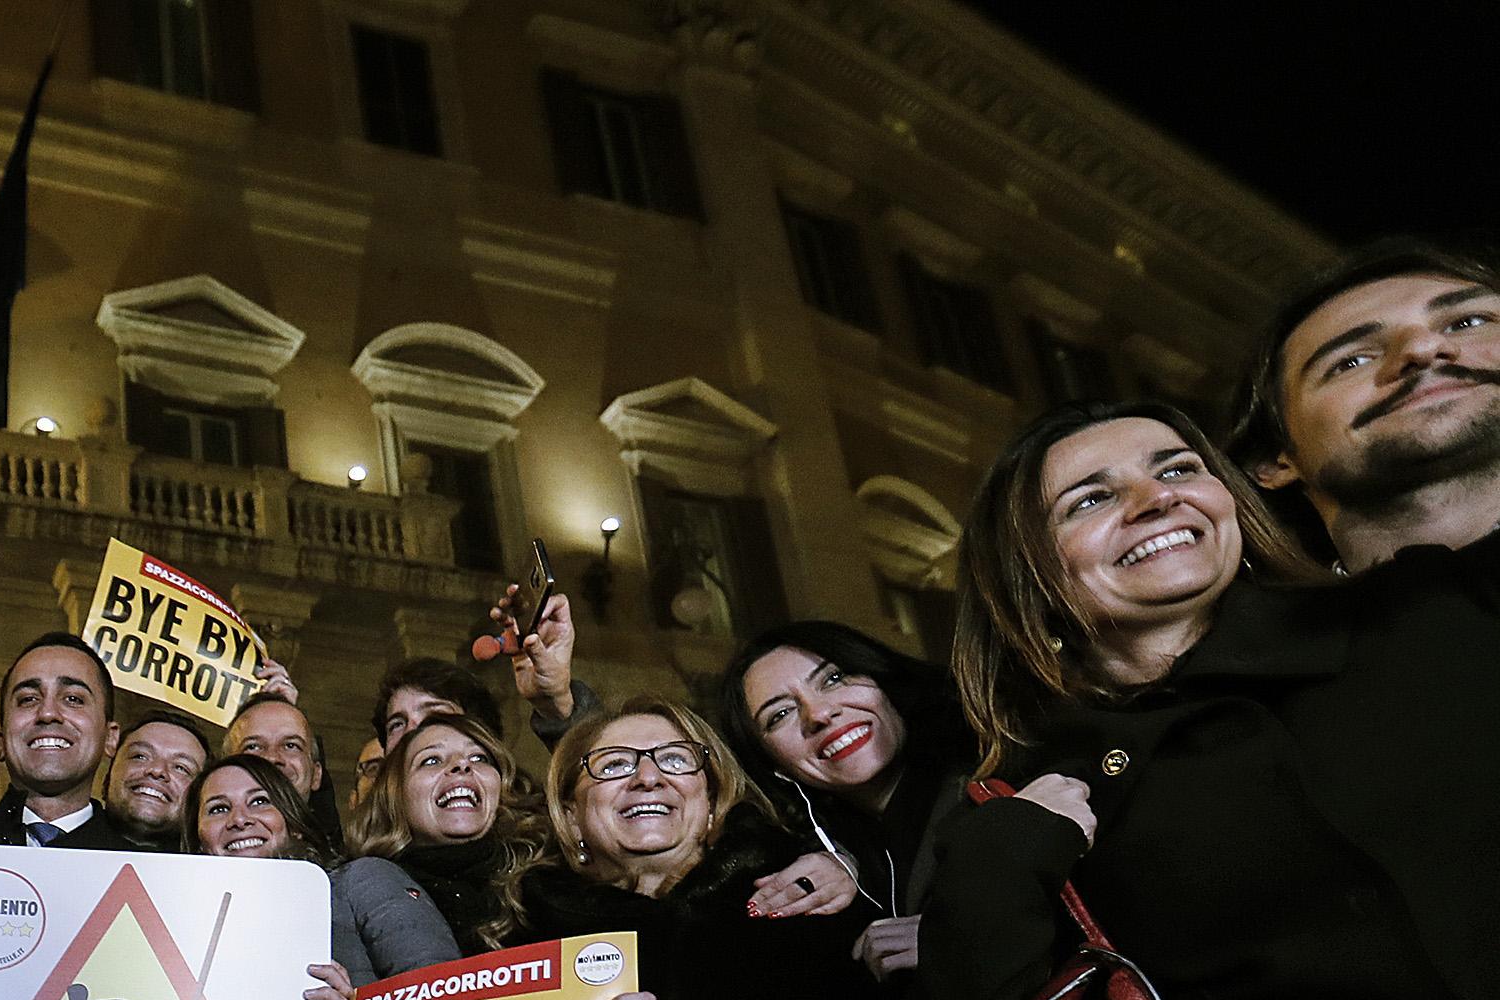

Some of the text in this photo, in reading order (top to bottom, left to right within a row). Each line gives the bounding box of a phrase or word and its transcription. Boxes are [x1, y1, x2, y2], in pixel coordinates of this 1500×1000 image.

[101, 576, 188, 646] BYE
[145, 562, 246, 626] SPAZZACORROTTI
[93, 625, 259, 710] CORROTT
